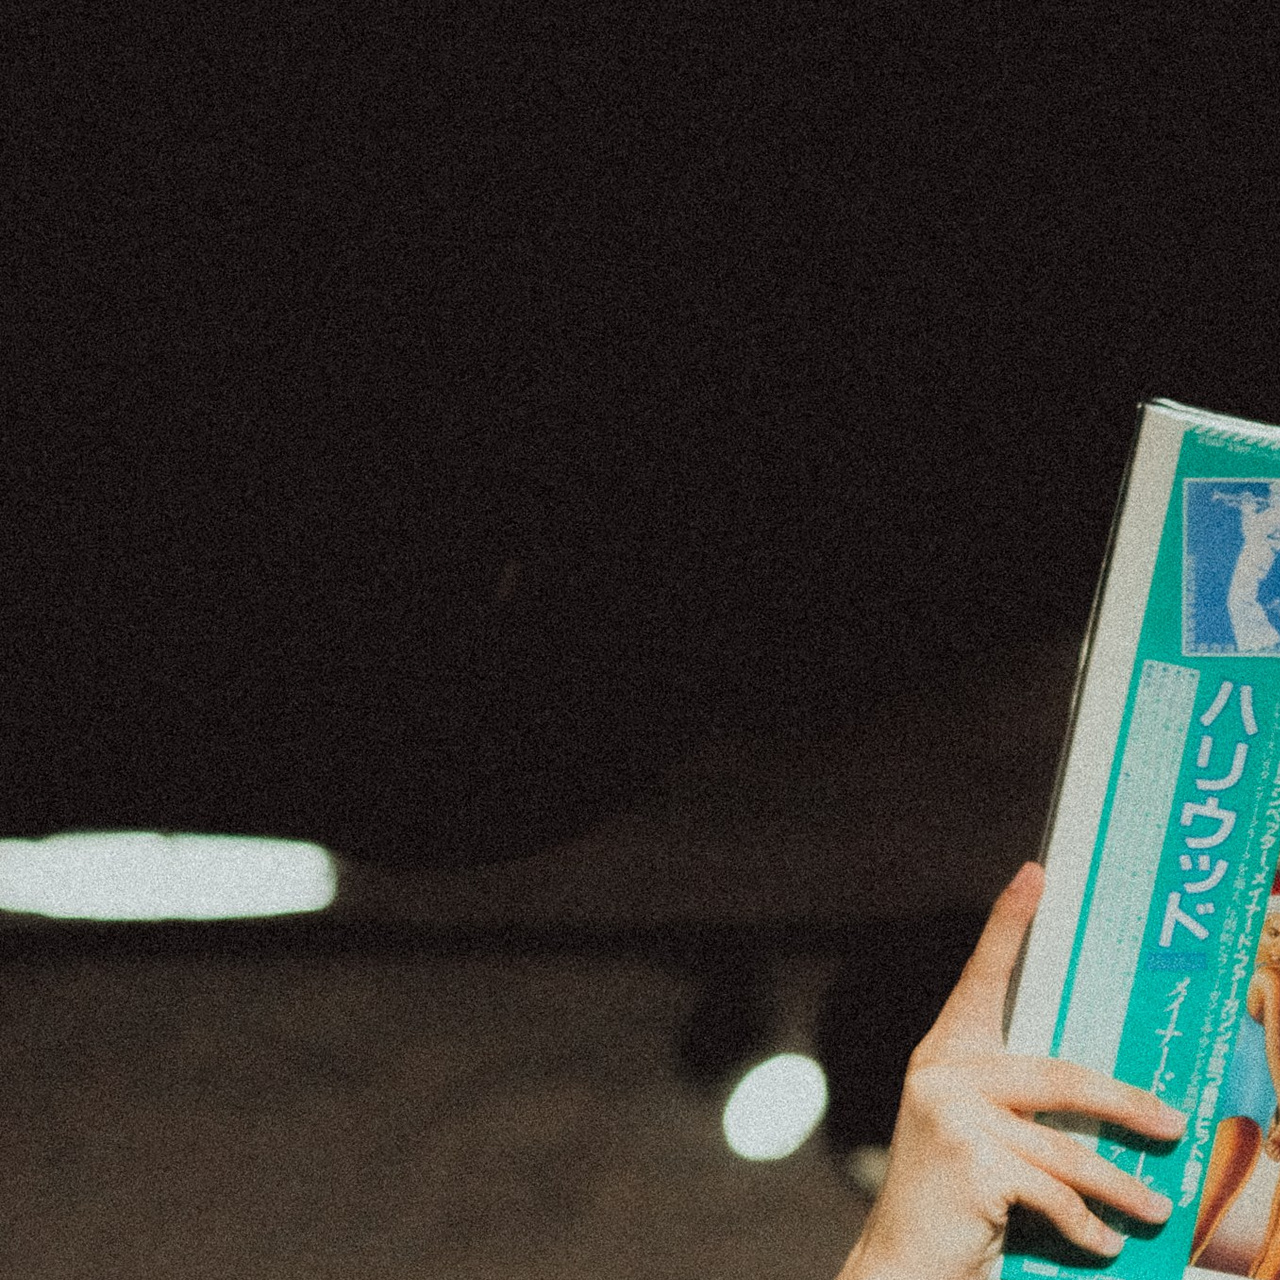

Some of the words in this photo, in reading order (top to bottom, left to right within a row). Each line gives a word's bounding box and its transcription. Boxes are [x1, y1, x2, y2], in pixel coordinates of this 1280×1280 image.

[1157, 680, 1260, 949] ハリウッド
